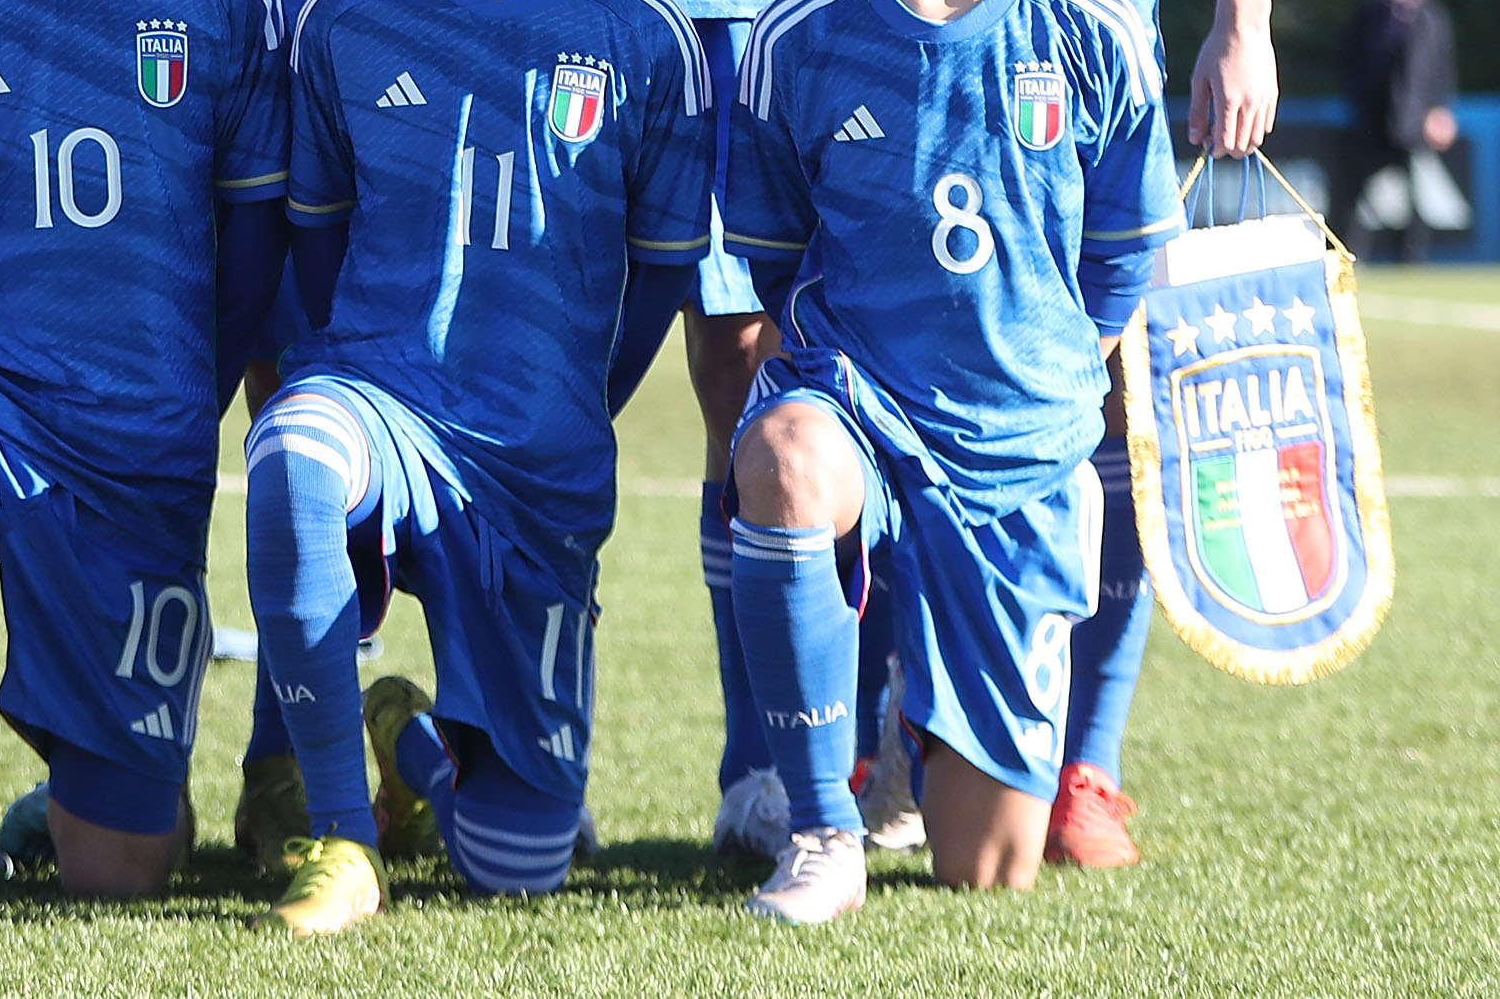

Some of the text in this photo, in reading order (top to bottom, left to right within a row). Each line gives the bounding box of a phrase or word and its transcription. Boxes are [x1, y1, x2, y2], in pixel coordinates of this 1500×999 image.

[141, 39, 183, 53] ITALIA
[558, 70, 600, 91] ITALIA
[1019, 80, 1061, 95] ITALIA
[29, 127, 122, 229] 10
[454, 146, 514, 250] 11
[931, 173, 994, 275] 8
[1183, 365, 1315, 438] ITALIA
[115, 581, 198, 687] 10
[540, 602, 588, 709] 11
[1024, 613, 1069, 715] 8
[766, 701, 848, 729] ITALIA
